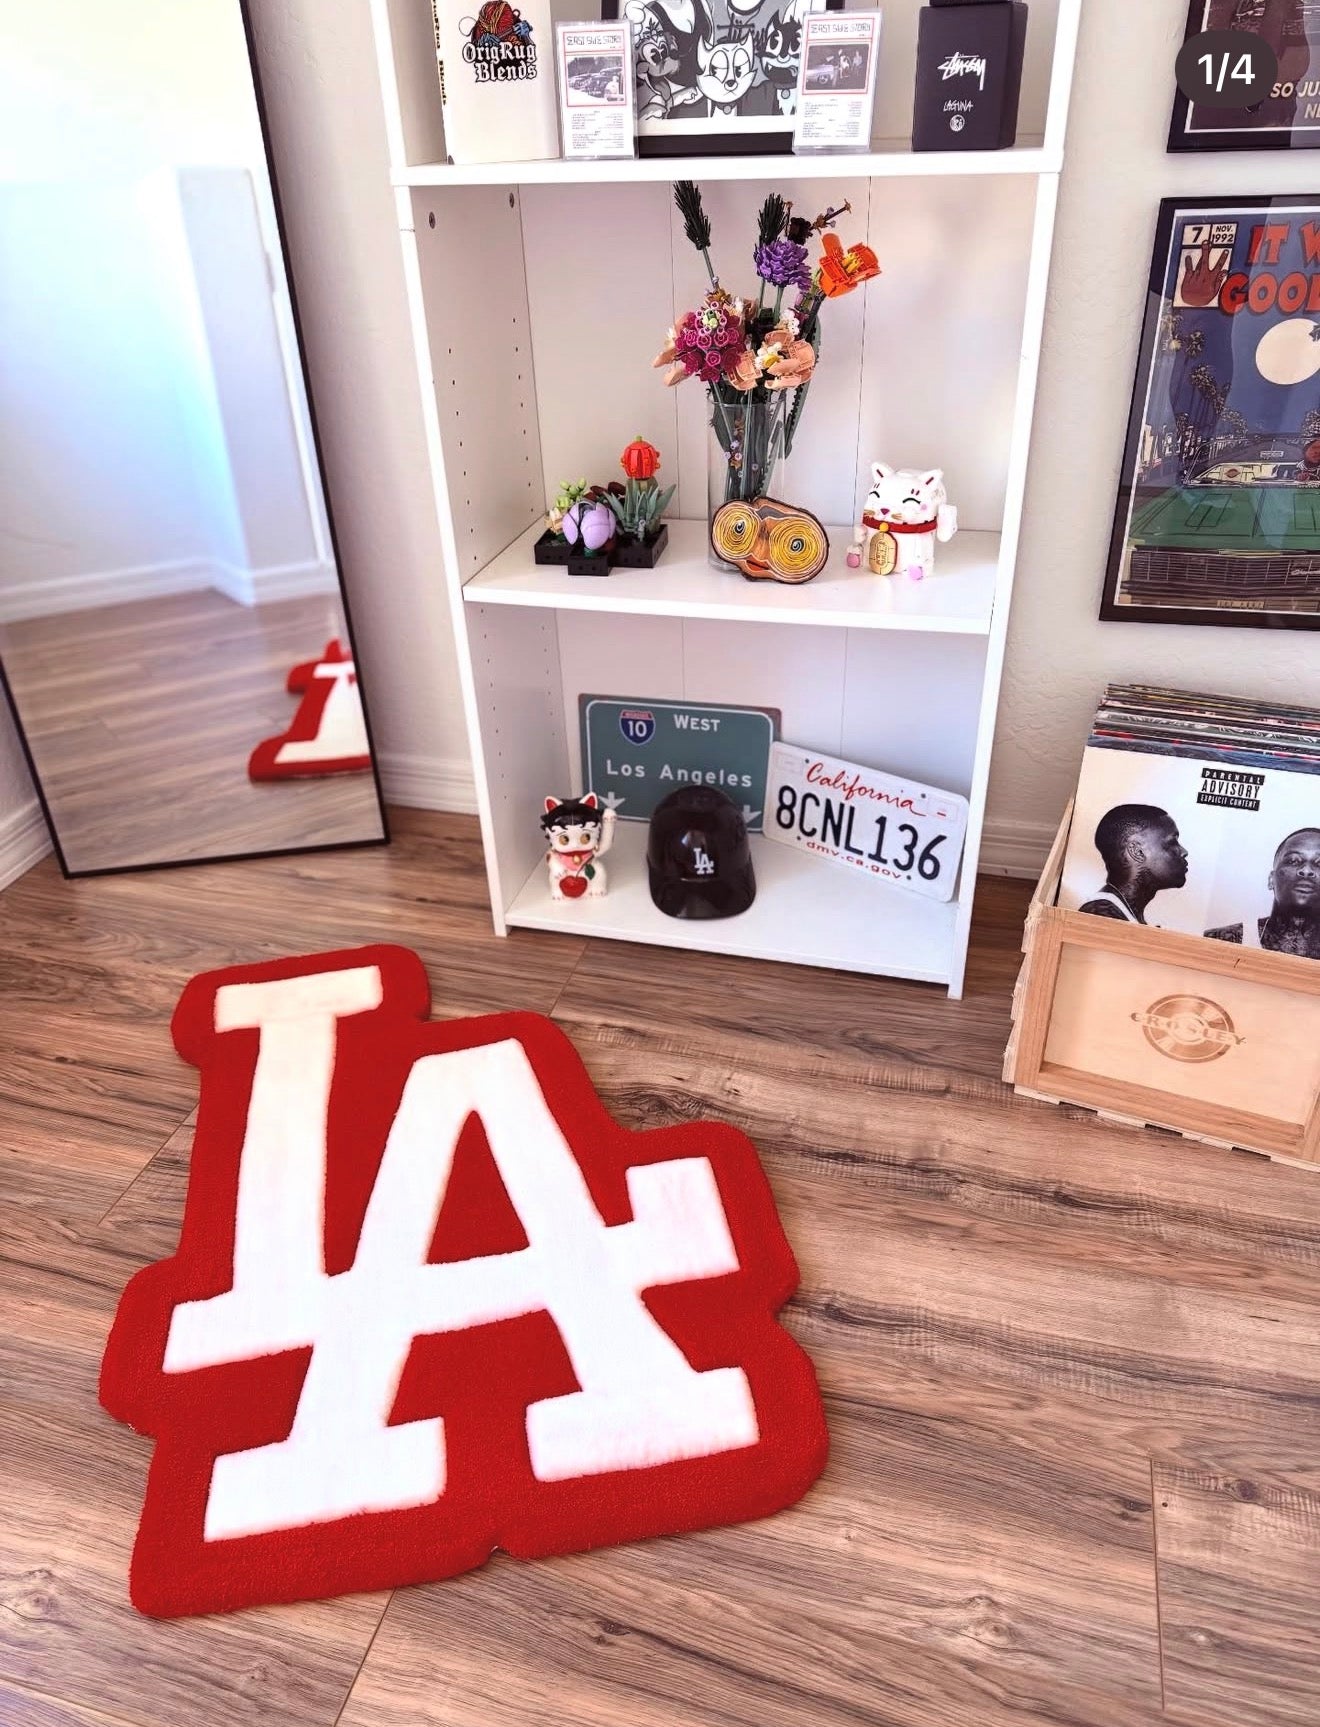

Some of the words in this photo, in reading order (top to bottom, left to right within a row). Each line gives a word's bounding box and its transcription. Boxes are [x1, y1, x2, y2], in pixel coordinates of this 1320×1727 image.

[462, 41, 537, 64] OrigRug
[474, 59, 538, 83] Blends
[1269, 82, 1294, 98] SO
[1297, 81, 1320, 98] JU
[943, 99, 974, 112] LAGUNA
[1192, 226, 1204, 243] 7
[1211, 233, 1235, 243] 1992
[1215, 225, 1234, 233] NOV.
[1246, 224, 1290, 266] IT
[627, 720, 647, 738] 10
[673, 714, 720, 732] WEST
[606, 759, 645, 778] Los
[659, 764, 753, 788] Angeles
[1205, 771, 1261, 785] PARENTAL
[806, 762, 926, 817] California
[1201, 779, 1261, 799] ADVISORY
[1201, 794, 1228, 804] EXPLICIT
[1229, 799, 1257, 809] CONTENT
[776, 785, 947, 881] 8CNL136
[693, 847, 714, 875] LA
[806, 841, 901, 879] dmv.ca.gov
[162, 965, 760, 1543] LA
